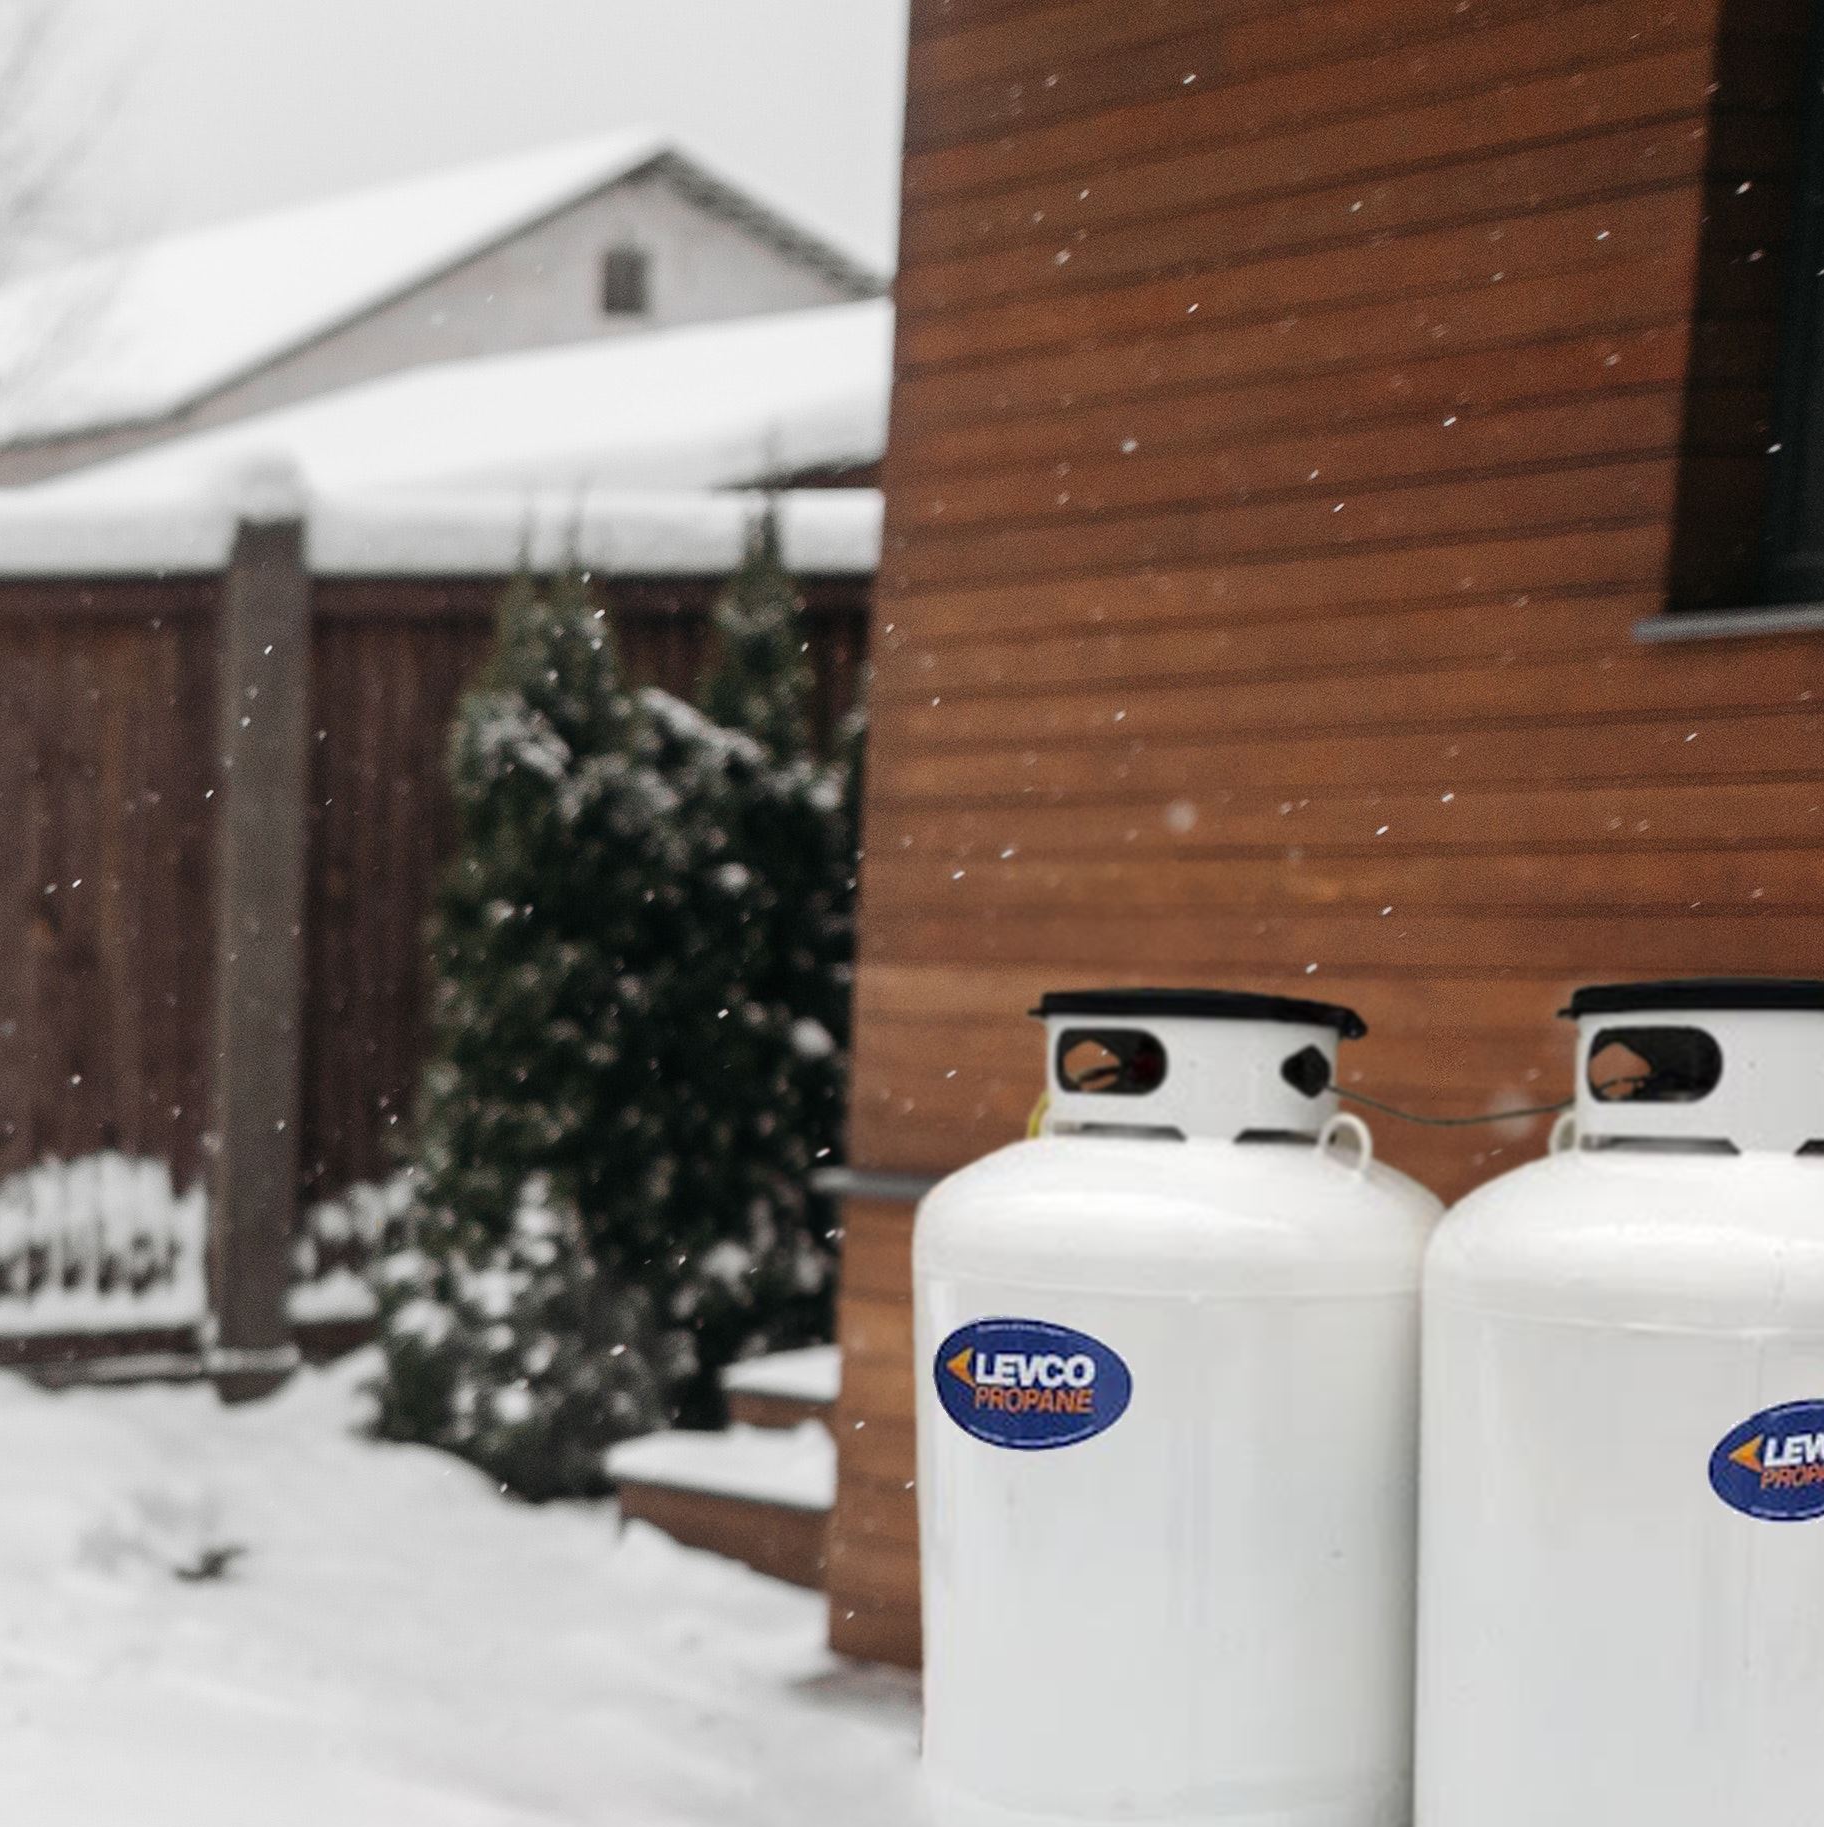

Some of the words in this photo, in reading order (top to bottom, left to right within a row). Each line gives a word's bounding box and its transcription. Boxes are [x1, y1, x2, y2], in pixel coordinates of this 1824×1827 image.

[975, 1352, 1095, 1388] LEVCO
[974, 1386, 1095, 1414] PROPANE
[1763, 1432, 1824, 1467] LEV
